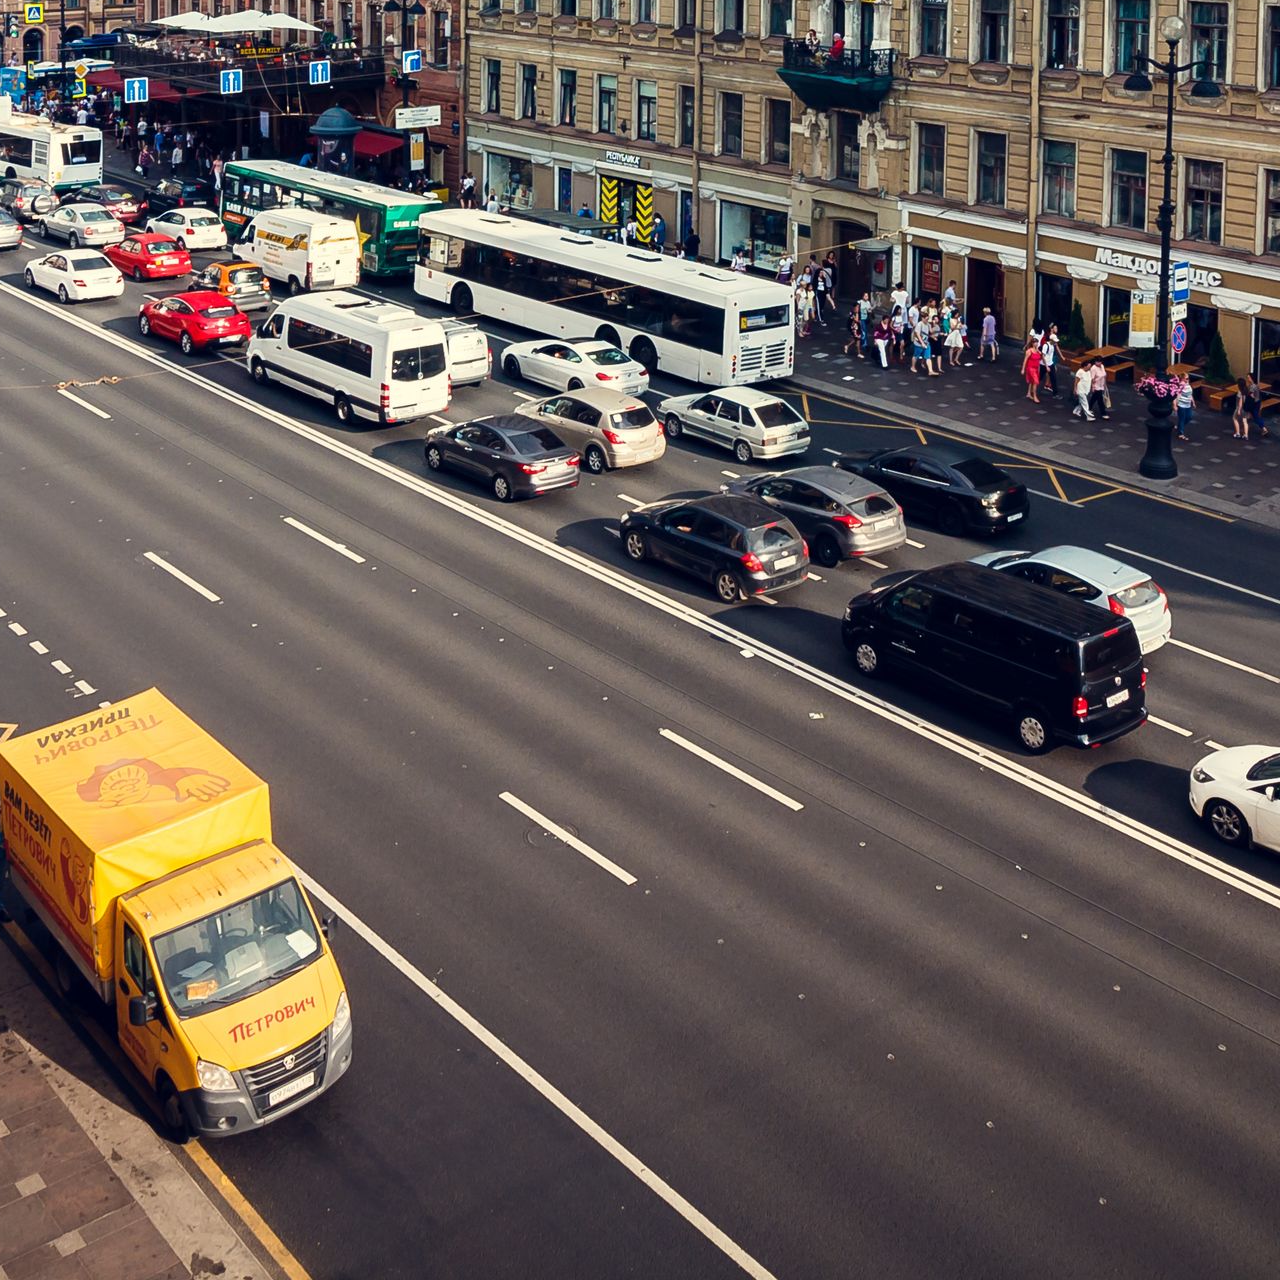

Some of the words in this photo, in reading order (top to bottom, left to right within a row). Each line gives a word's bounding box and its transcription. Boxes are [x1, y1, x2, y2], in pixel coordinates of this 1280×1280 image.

[34, 714, 163, 765] ПЕТРОВИЧ
[37, 707, 131, 748] ПРИЕХАЛ
[4, 780, 23, 815] ВАМ
[3, 799, 57, 883] ПЕТРОВИЧ
[228, 996, 316, 1044] ПЕТРОВИЧ
